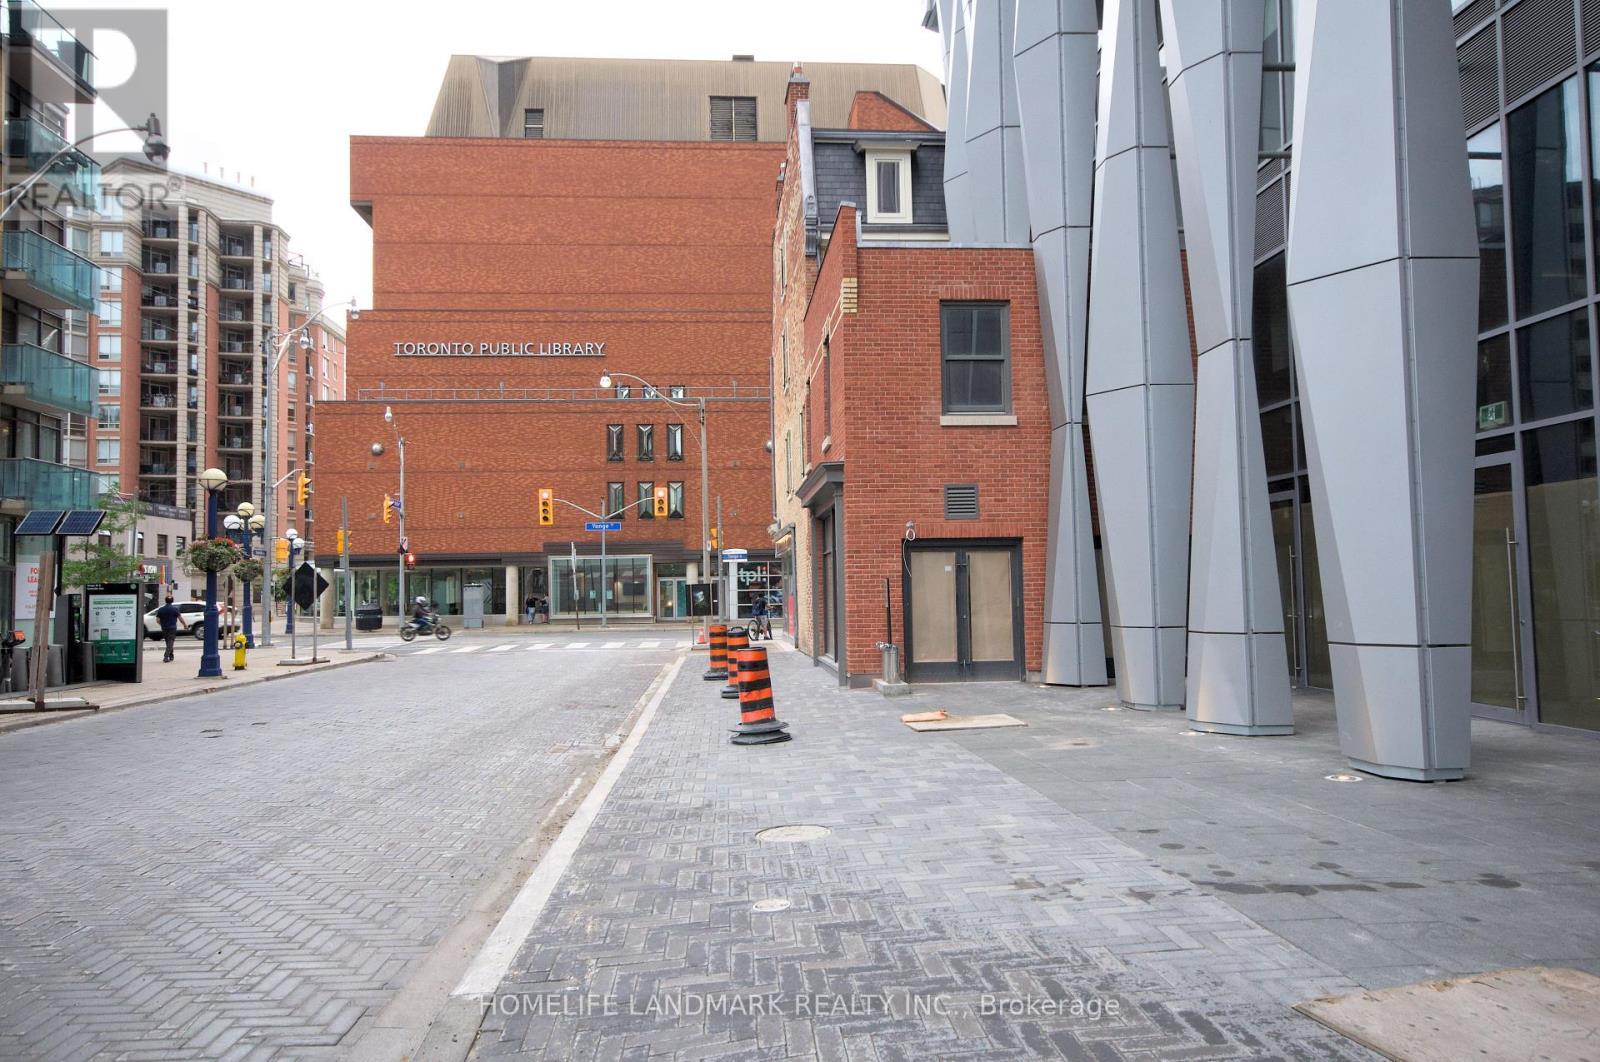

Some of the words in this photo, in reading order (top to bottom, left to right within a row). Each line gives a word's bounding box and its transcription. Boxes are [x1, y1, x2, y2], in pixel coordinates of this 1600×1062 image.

[393, 342, 473, 355] TORONTO
[480, 342, 534, 355] PUBLIC
[540, 342, 605, 355] LIBRARY
